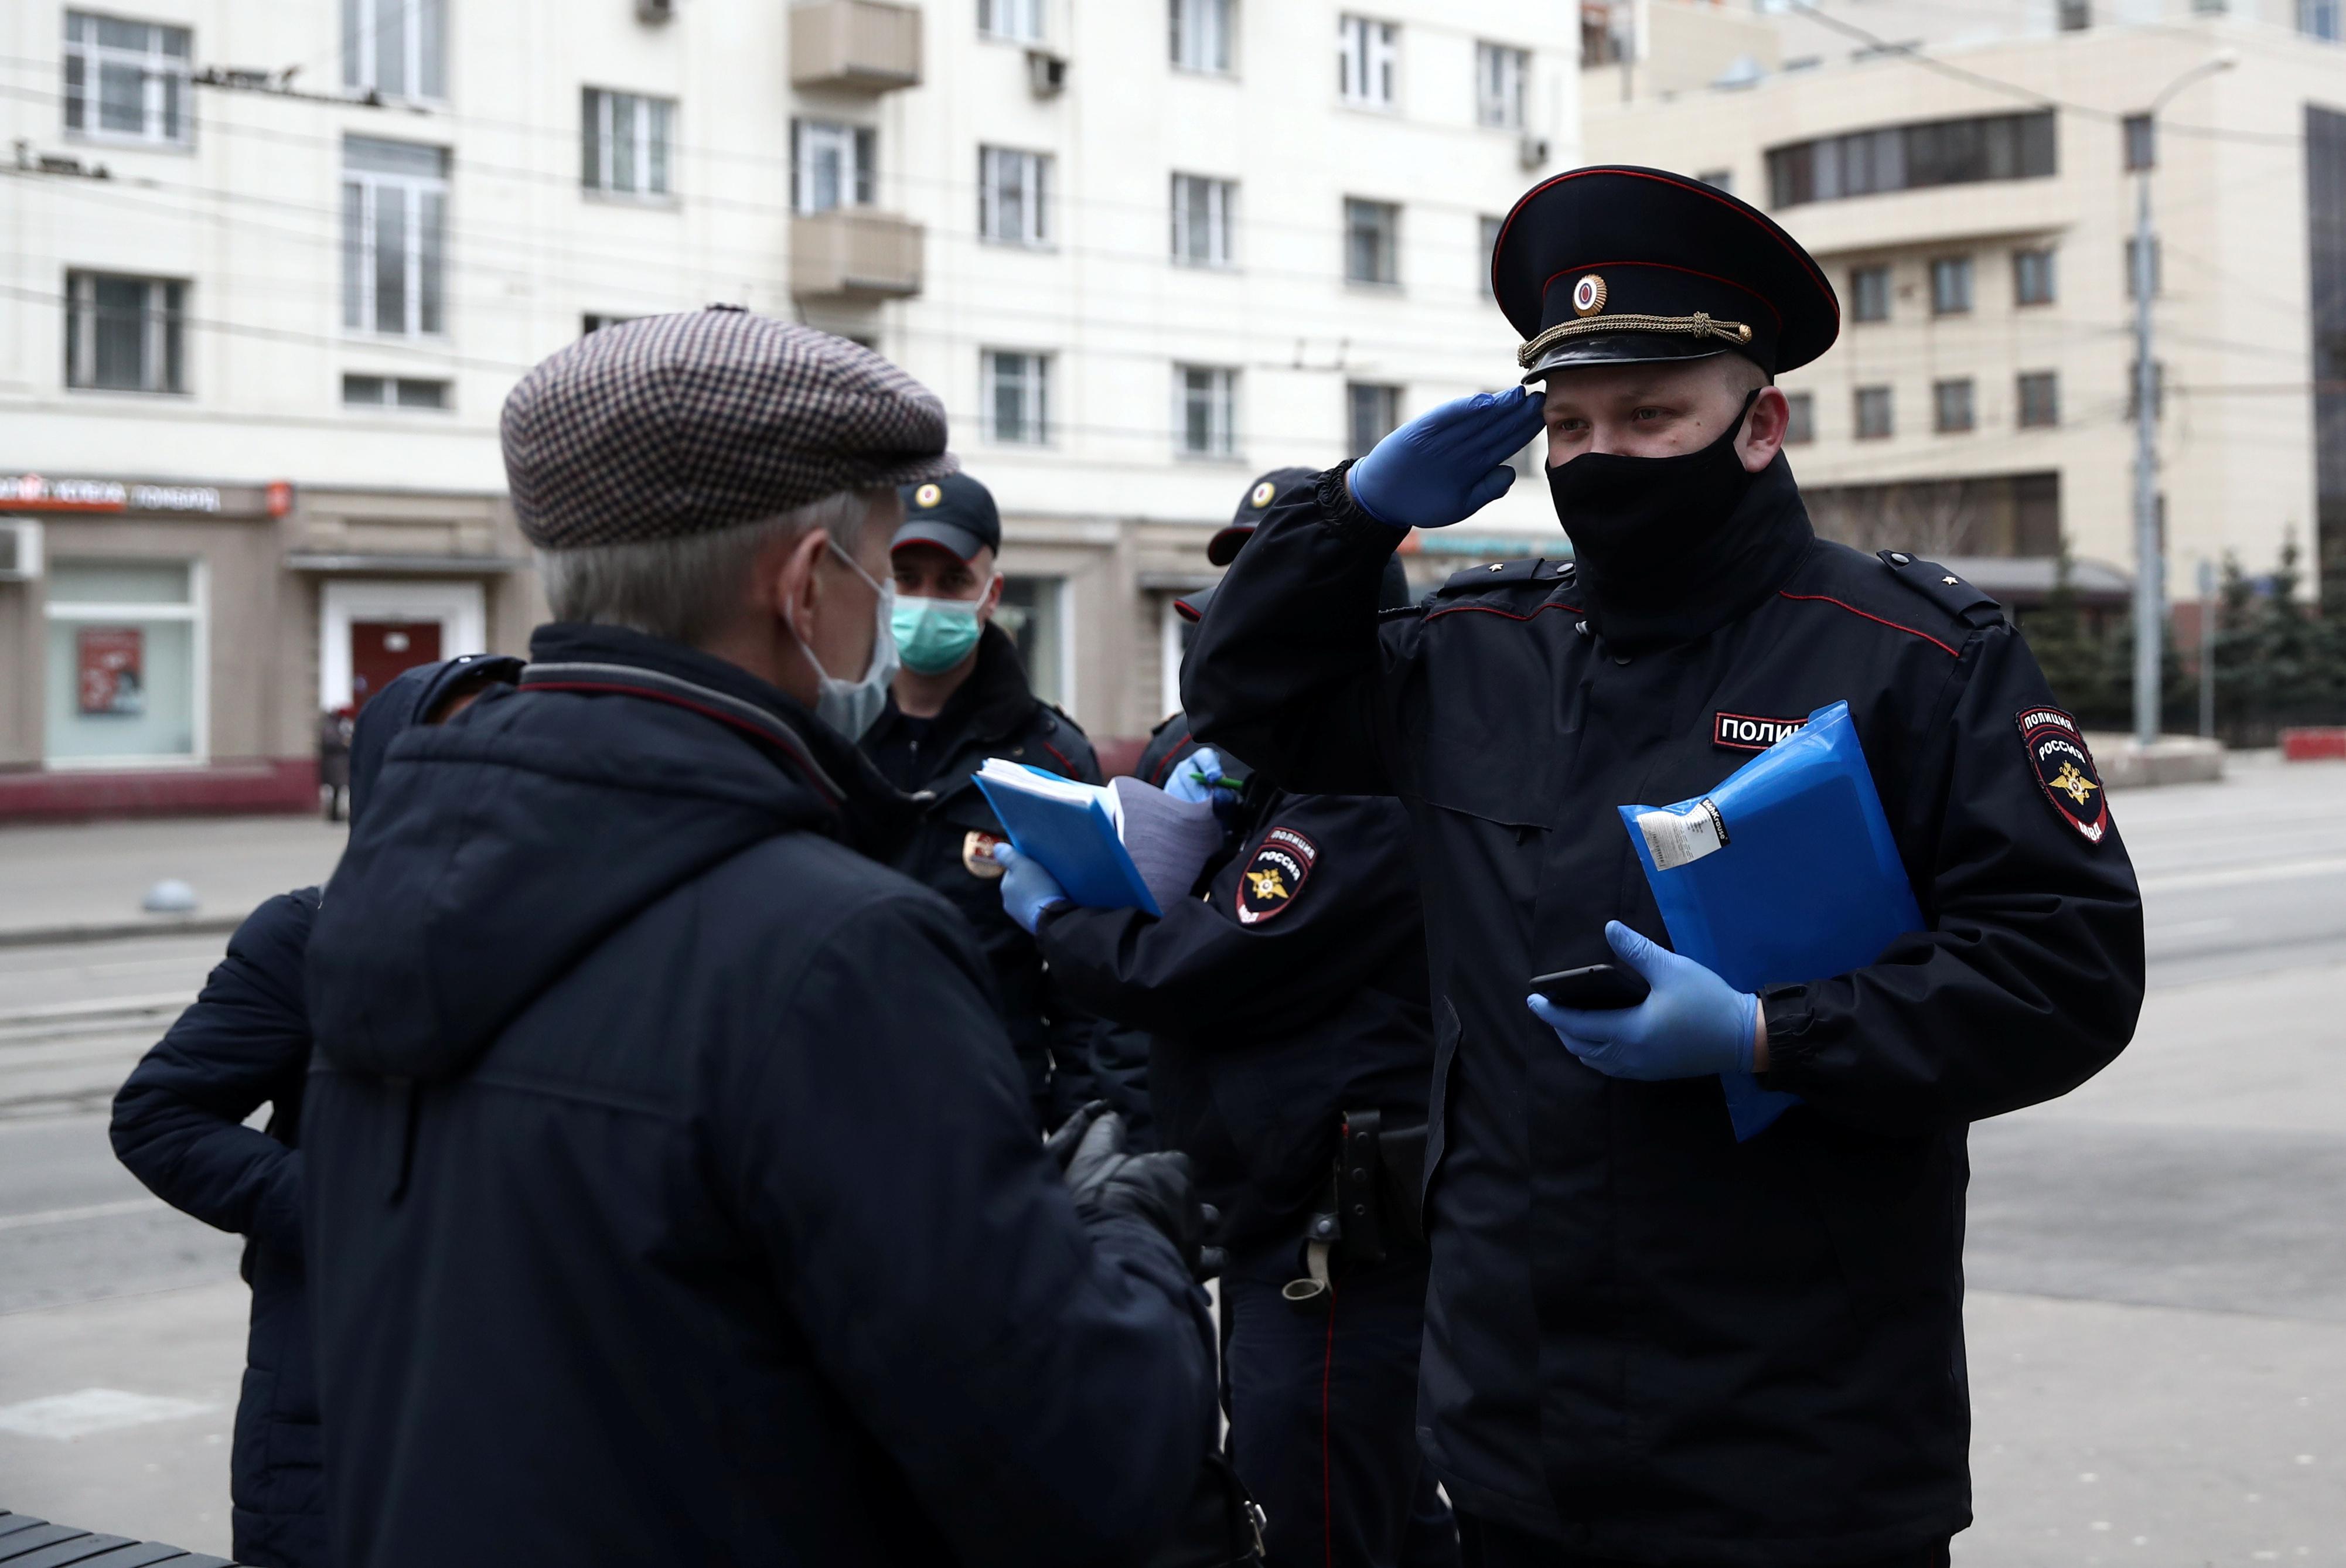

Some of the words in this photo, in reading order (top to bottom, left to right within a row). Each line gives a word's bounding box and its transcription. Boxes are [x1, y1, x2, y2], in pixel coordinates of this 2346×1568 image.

[2024, 712, 2074, 732] ПОЛИЦИЯ
[2038, 740, 2086, 765] РОССИЯ
[2078, 821, 2102, 841] МВД
[1270, 830, 1315, 860] ПОЛИЦИЯ
[1258, 851, 1301, 881] РОССИЯ
